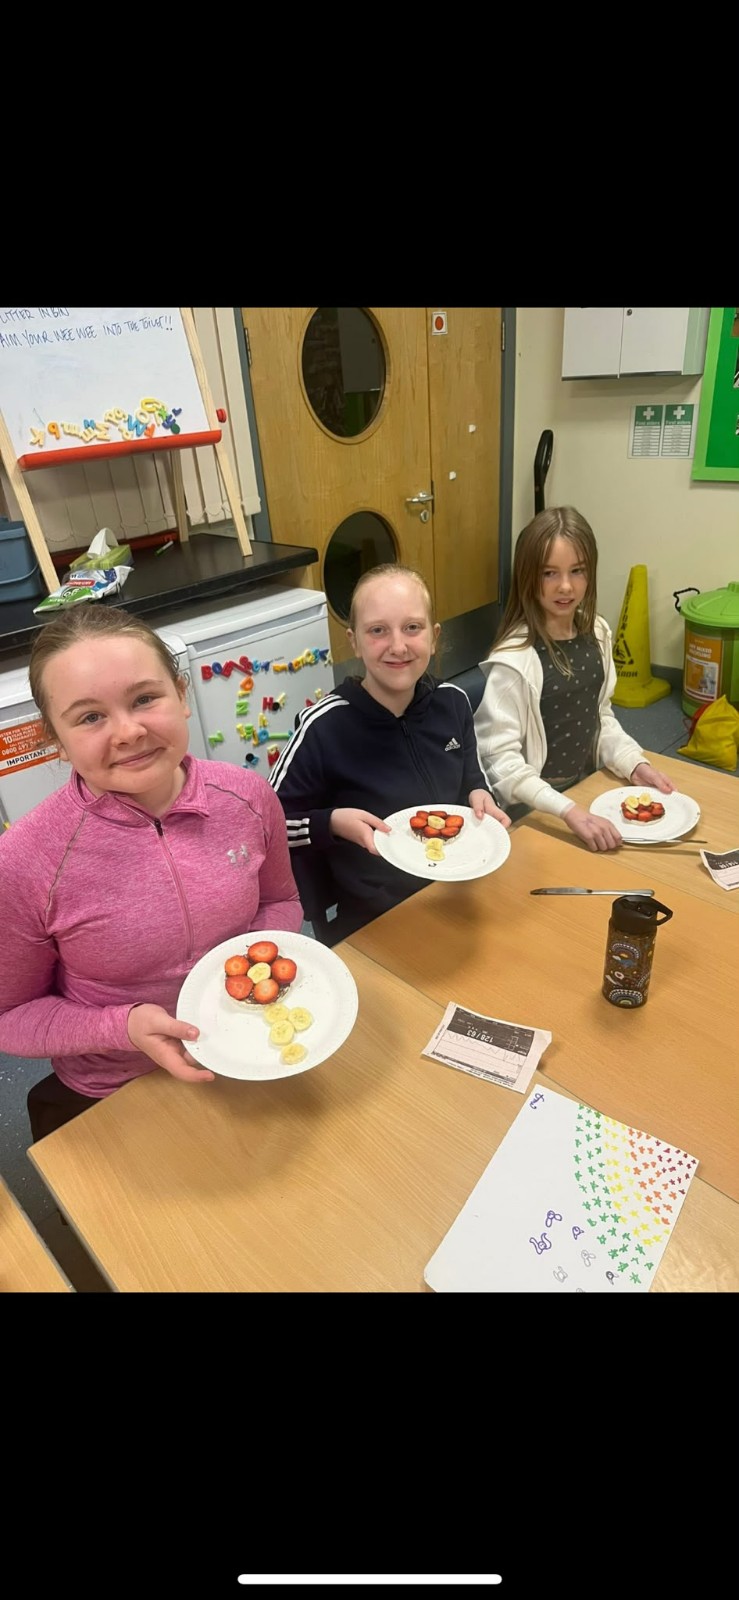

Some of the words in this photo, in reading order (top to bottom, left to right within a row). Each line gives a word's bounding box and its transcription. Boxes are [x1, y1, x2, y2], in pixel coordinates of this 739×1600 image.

[0, 333, 23, 348] AIM
[22, 329, 54, 349] YOUR
[53, 328, 76, 342] WEE
[76, 325, 98, 340] WEE
[103, 322, 122, 336] INTO
[3, 736, 12, 745] 10
[6, 748, 47, 767] IMPORTANT
